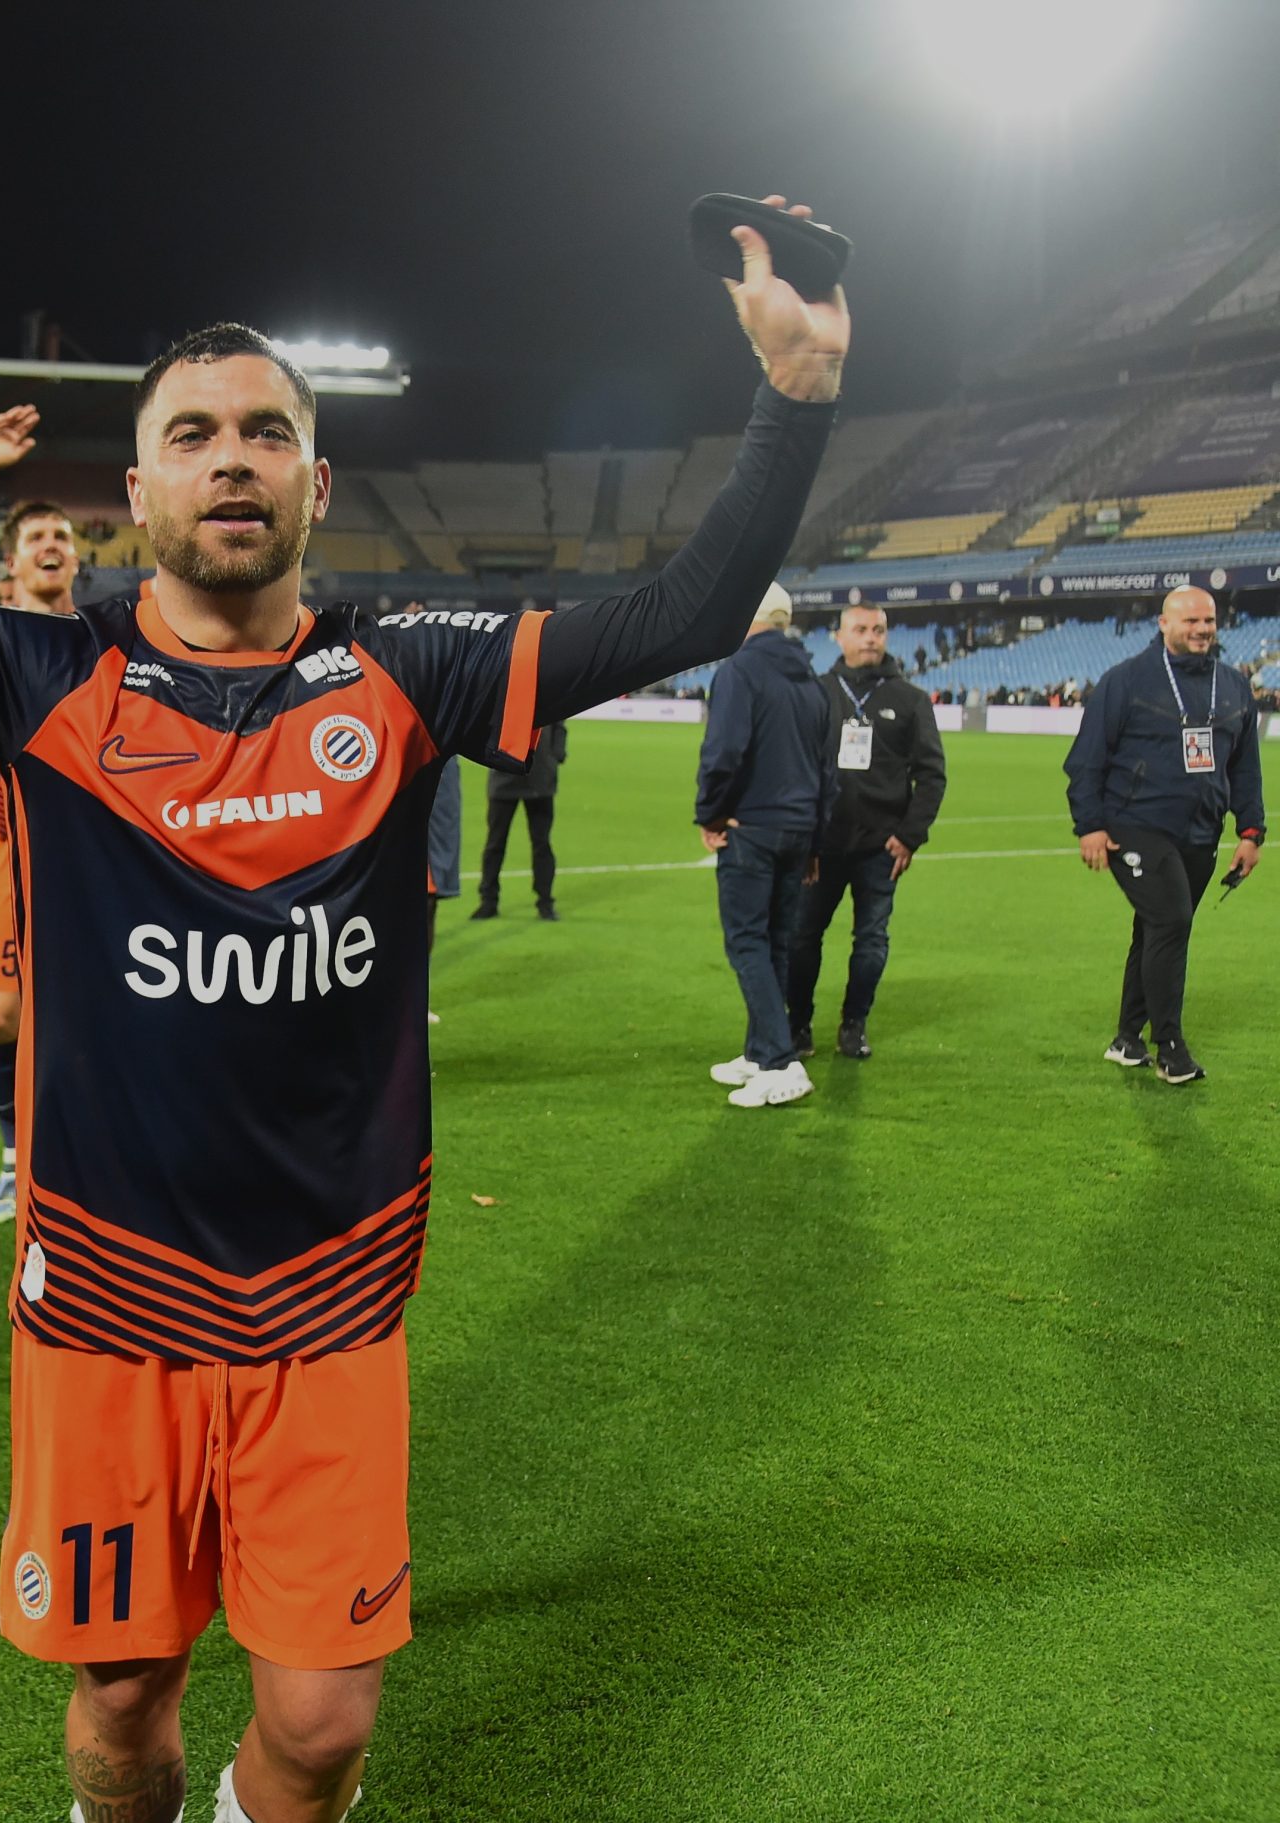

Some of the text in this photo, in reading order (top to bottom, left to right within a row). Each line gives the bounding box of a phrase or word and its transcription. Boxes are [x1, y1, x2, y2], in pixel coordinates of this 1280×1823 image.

[976, 582, 999, 595] NIKE
[294, 646, 360, 684] BIG
[196, 790, 323, 828] FAUN
[124, 904, 376, 1005] swile
[61, 1522, 134, 1626] 11
